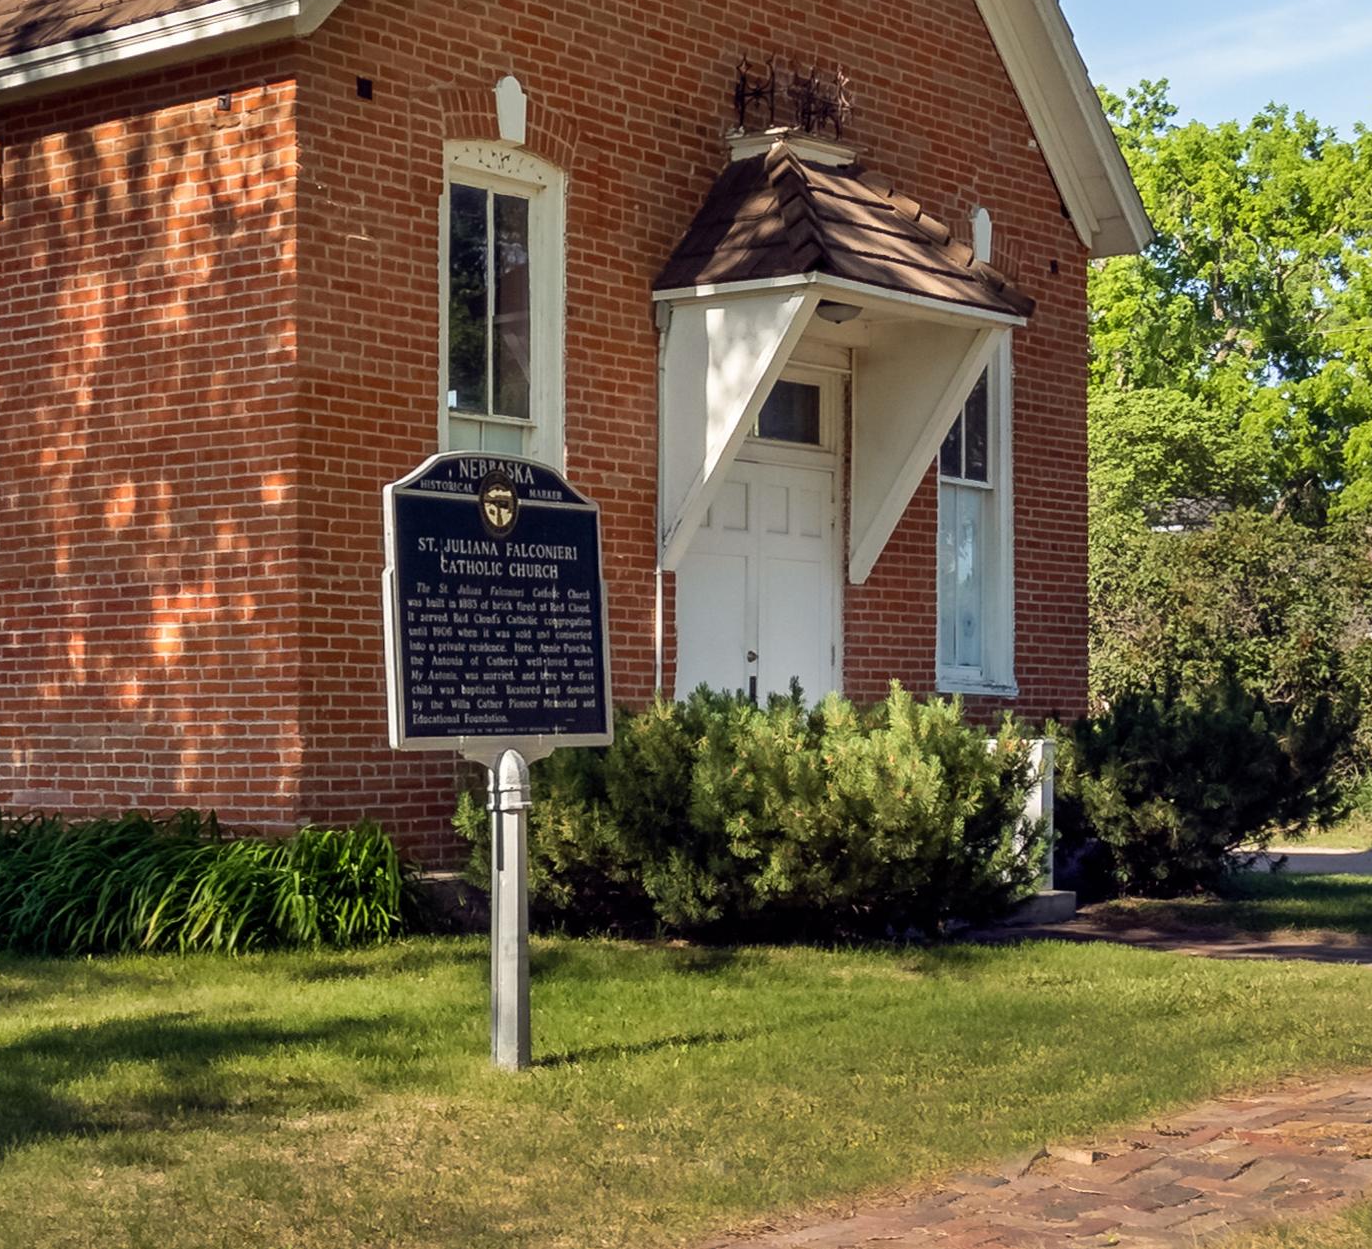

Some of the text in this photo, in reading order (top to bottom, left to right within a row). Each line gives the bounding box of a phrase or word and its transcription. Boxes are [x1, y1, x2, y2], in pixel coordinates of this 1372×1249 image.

[459, 459, 534, 485] NEBRASKA
[420, 479, 563, 501] HISTORICAL MARKER
[418, 537, 578, 561] ST. JULIANA FALCONIERI
[441, 558, 558, 579] CATHOLIC CHURCH
[417, 582, 430, 593] The
[568, 588, 590, 599] Church
[407, 599, 422, 607] was
[426, 597, 445, 608] built
[448, 599, 456, 608] in
[480, 600, 488, 609] of
[492, 600, 513, 610] brick
[516, 601, 536, 611] fired
[539, 602, 547, 612] at
[550, 602, 564, 612] Red
[408, 610, 415, 622] It
[420, 612, 448, 622] served
[453, 612, 468, 623] Red
[506, 615, 538, 625] Catholic
[544, 617, 591, 628] congregation
[408, 626, 427, 636] until
[458, 628, 477, 637] when
[483, 627, 489, 637] it
[495, 630, 510, 638] was
[515, 629, 531, 639] sold
[536, 630, 550, 639] and
[555, 631, 592, 640] converted
[409, 640, 426, 651] into
[429, 643, 435, 651] a
[438, 641, 466, 653] private
[469, 642, 508, 652] residence.
[539, 643, 561, 653] Annie
[410, 656, 424, 666] the
[432, 655, 463, 666] Antonia
[470, 656, 479, 666] of
[411, 669, 423, 681] My
[465, 672, 479, 680] was
[522, 671, 535, 680] and
[561, 671, 574, 680] her
[579, 670, 594, 680] first
[411, 684, 432, 695] child
[439, 687, 455, 695] was
[506, 685, 541, 695] Restored
[545, 685, 560, 695] and
[566, 684, 595, 694] donated
[412, 698, 595, 711] by the Willa Cather Pioneer Memorial and
[413, 713, 460, 724] Educational
